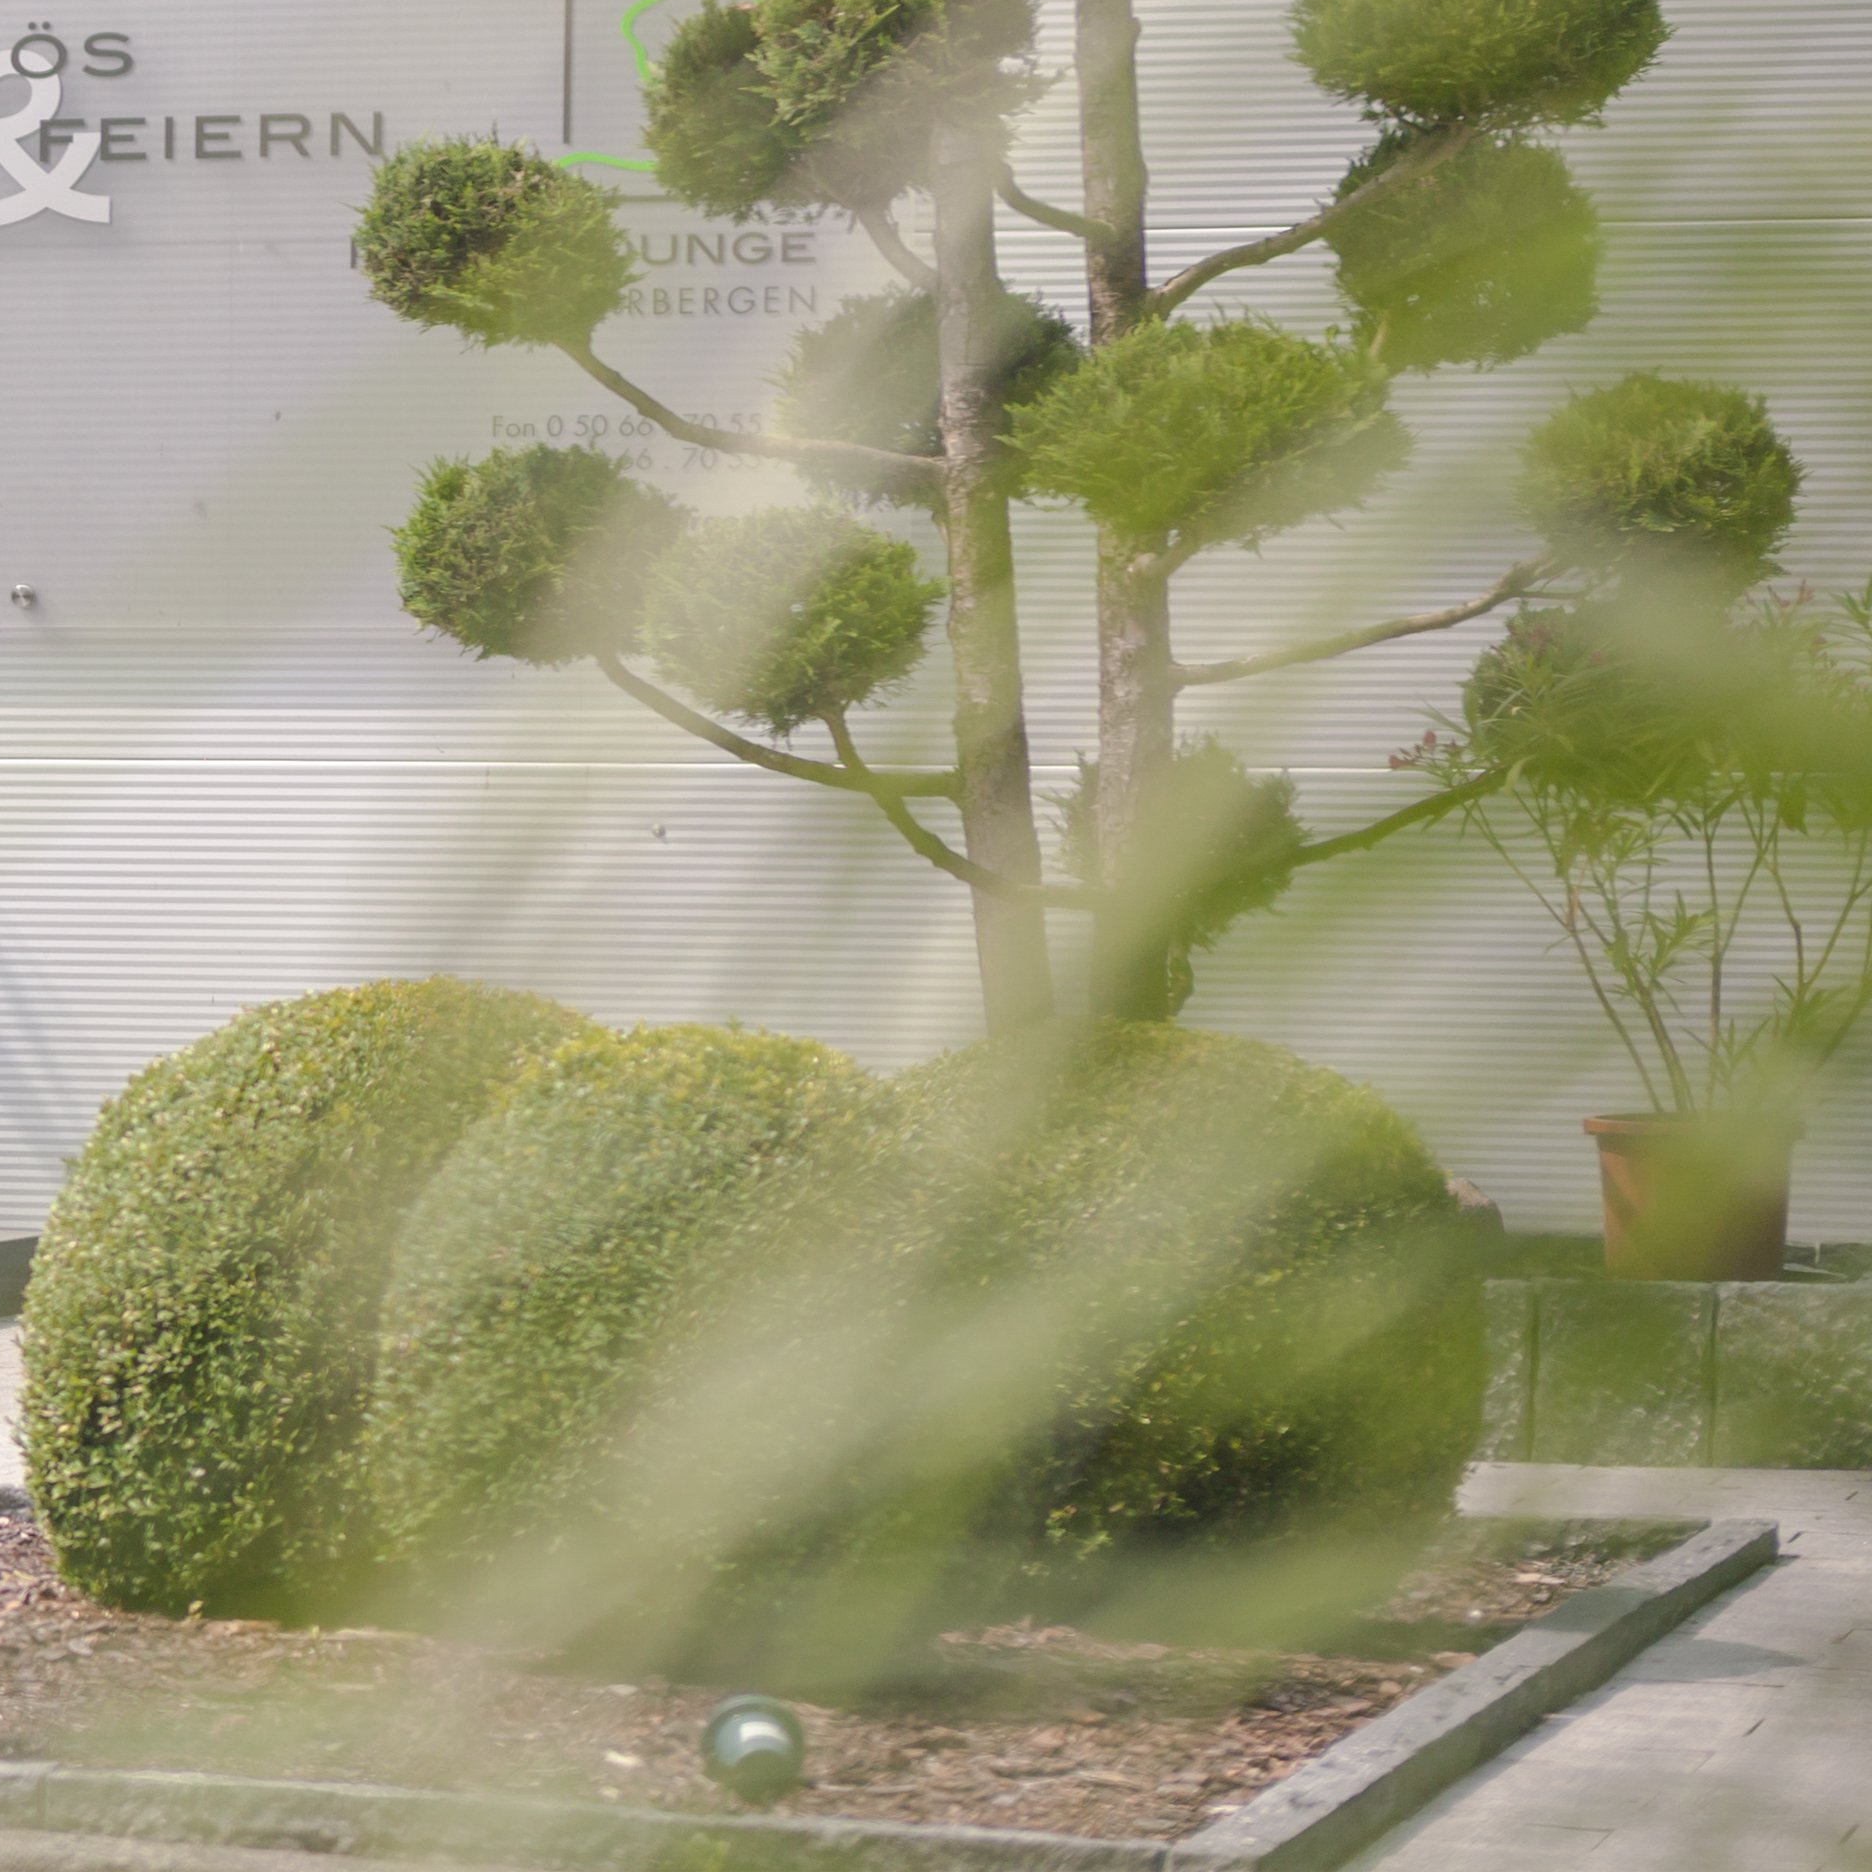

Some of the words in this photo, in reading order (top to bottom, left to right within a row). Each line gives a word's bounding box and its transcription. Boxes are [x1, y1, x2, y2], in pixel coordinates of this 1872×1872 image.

[39, 111, 383, 162] FEIERN
[622, 231, 817, 266] UNGE
[616, 285, 817, 317] RBERGEN
[492, 414, 536, 437] Fon
[547, 414, 564, 437] 0
[574, 413, 608, 437] 50
[619, 413, 655, 437] 66
[682, 447, 717, 470] 70
